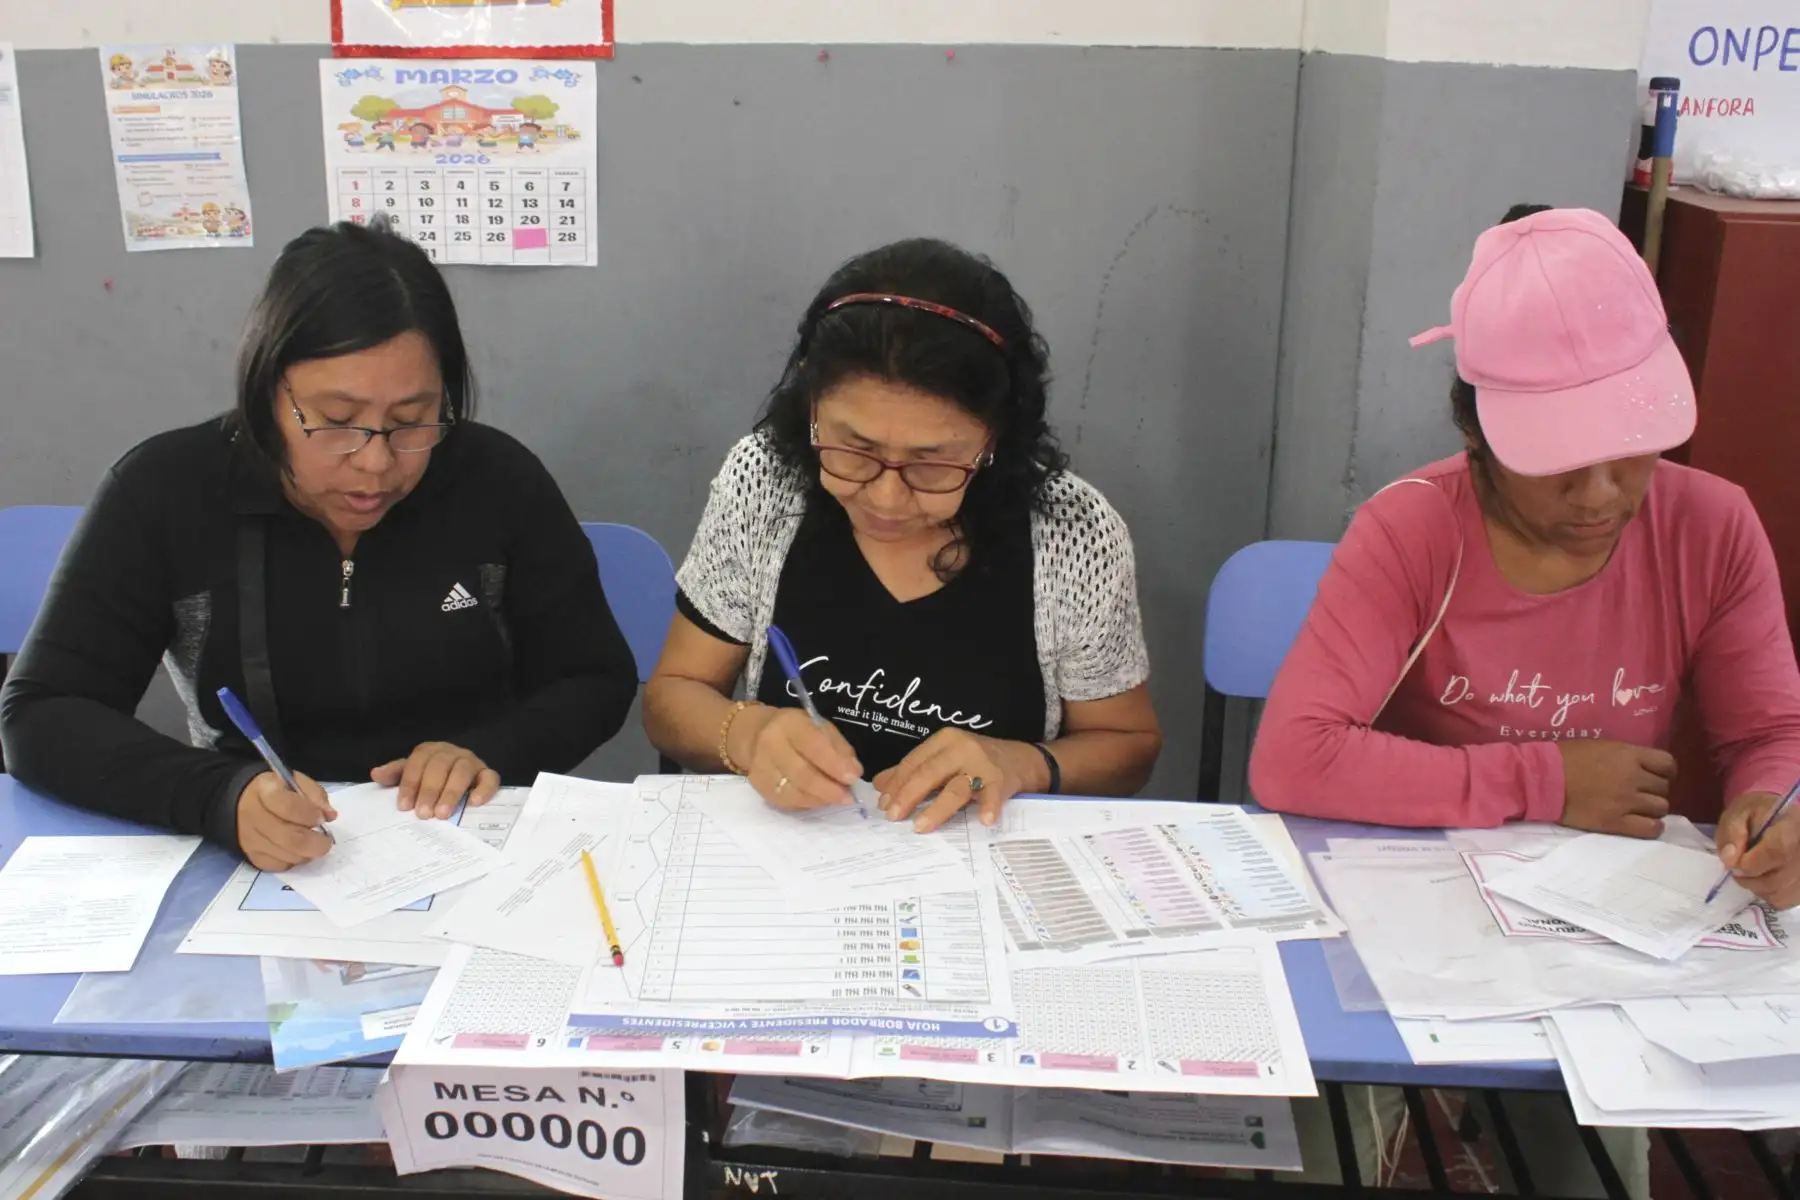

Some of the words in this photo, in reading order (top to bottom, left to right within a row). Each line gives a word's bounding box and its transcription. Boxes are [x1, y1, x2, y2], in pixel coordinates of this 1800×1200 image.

[1688, 25, 1800, 71] ONPE
[395, 68, 518, 84] MARZO
[1679, 96, 1755, 117] ANFORA
[435, 153, 490, 165] 2026
[351, 181, 359, 190] 1
[385, 181, 395, 190] 2
[420, 181, 430, 190] 3
[456, 181, 465, 190] 4
[489, 182, 500, 191] 5
[524, 182, 534, 191] 6
[561, 182, 571, 191] 7
[351, 198, 361, 207] 8
[385, 198, 395, 207] 9
[417, 198, 434, 207] 10
[456, 198, 468, 207] 11
[487, 198, 503, 207] 12
[522, 199, 539, 208] 13
[559, 199, 575, 208] 14
[419, 215, 434, 224] 17
[455, 215, 470, 224] 18
[487, 216, 503, 225] 19
[520, 216, 540, 225] 20
[558, 216, 576, 225] 21
[418, 232, 436, 241] 24
[454, 232, 472, 241] 25
[485, 233, 506, 242] 26
[557, 233, 577, 242] 28
[441, 597, 478, 612] adidas
[786, 656, 993, 729] Confidence
[1440, 675, 1474, 706] Do
[1489, 669, 1552, 708] what
[1551, 691, 1595, 726] you
[837, 704, 860, 717] wear
[862, 709, 870, 719] it
[872, 711, 889, 724] like
[890, 717, 916, 731] make
[917, 725, 930, 736] up
[1500, 725, 1603, 741] Everyday
[622, 1017, 735, 1029] VICEPRESIDENTES
[739, 1021, 748, 1029] Y
[751, 1017, 828, 1028] PRESIDENTE
[832, 1017, 903, 1030] BORRADOR
[907, 1020, 940, 1031] HOJA
[433, 1081, 566, 1103] MESA
[424, 1111, 646, 1166] 000000
